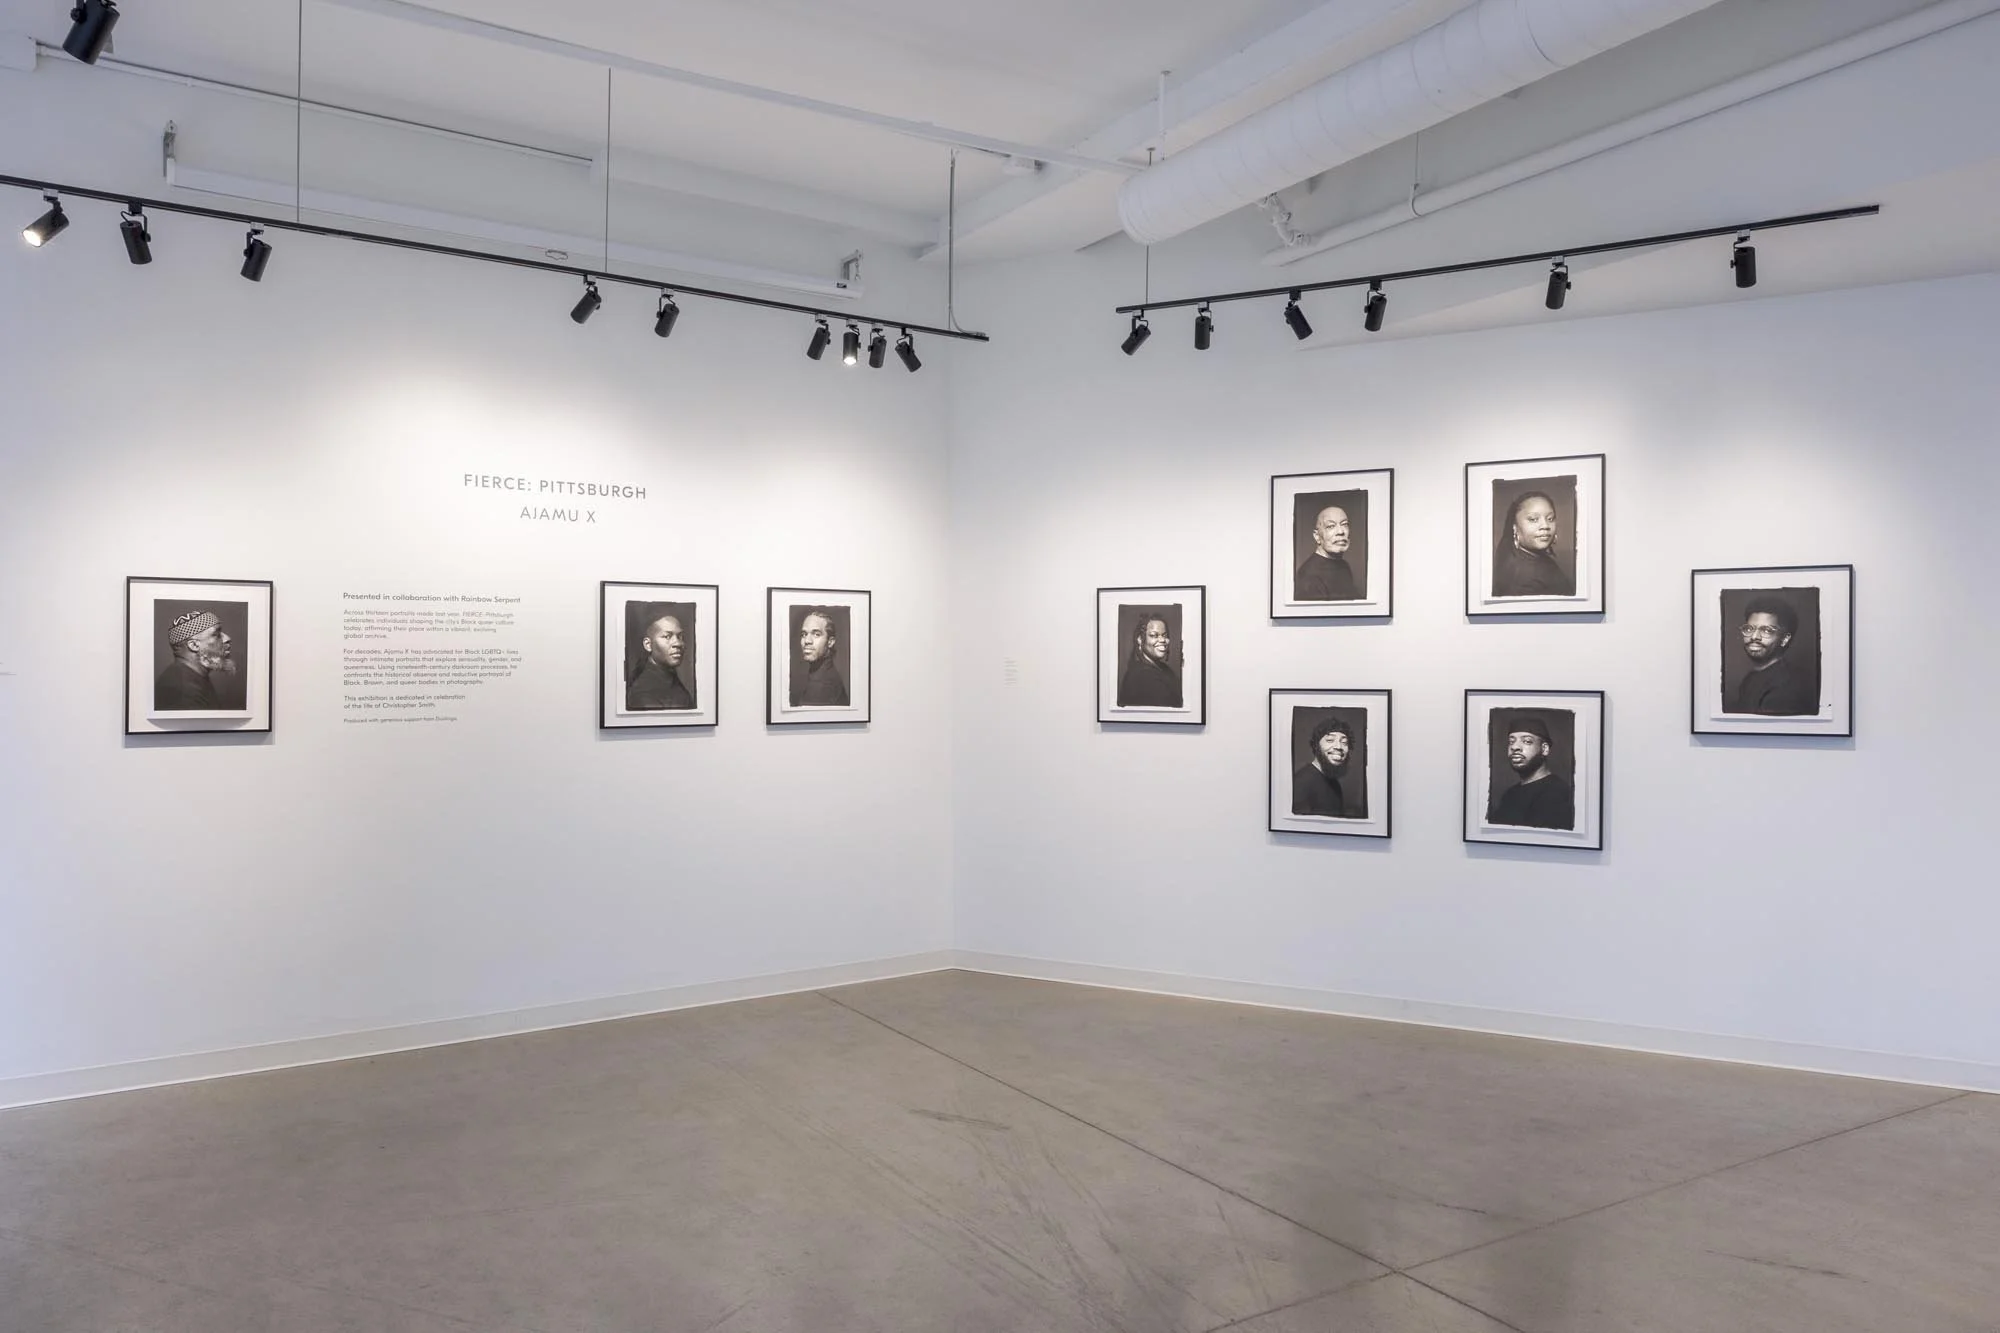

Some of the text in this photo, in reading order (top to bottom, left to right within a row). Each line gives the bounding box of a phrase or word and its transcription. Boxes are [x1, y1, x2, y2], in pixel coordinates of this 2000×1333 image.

[463, 473, 647, 500] FIERCE: PITTSBURGH
[519, 506, 596, 523] AJAMU X
